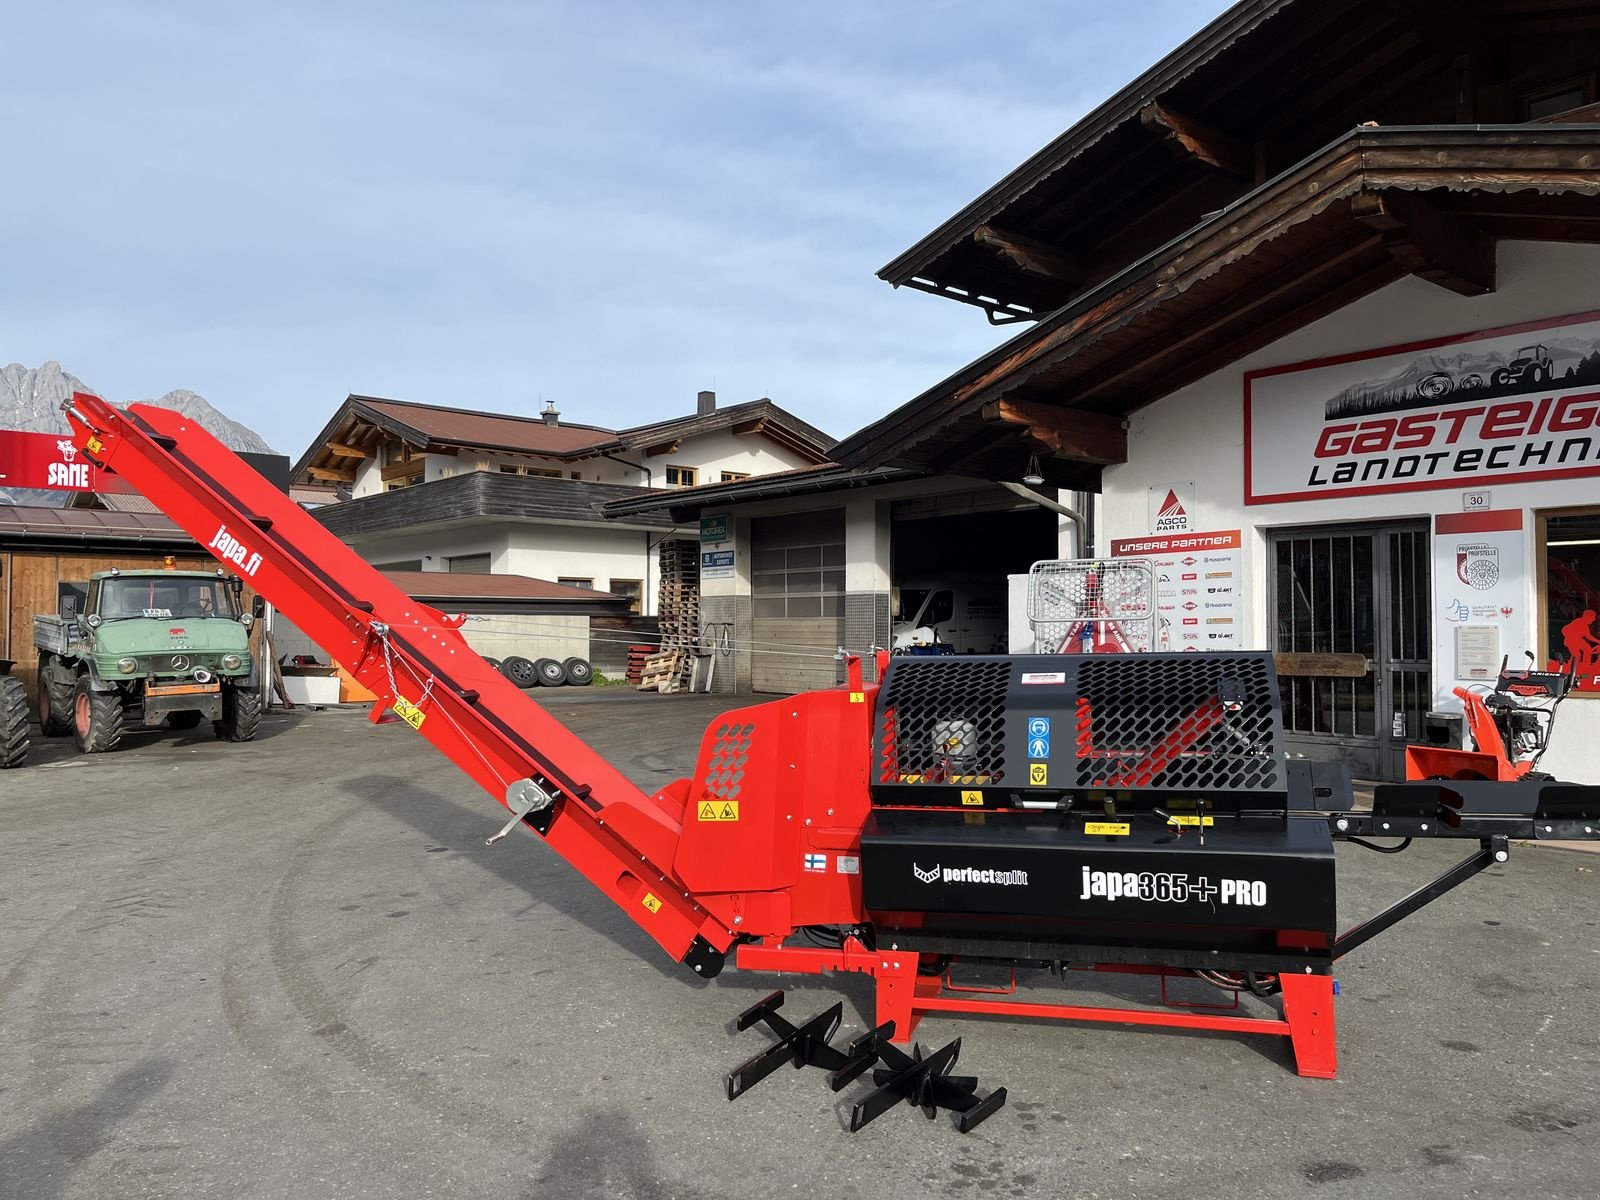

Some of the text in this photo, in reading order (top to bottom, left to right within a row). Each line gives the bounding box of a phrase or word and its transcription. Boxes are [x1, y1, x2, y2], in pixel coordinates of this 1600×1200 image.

[47, 462, 89, 488] SAME
[1470, 496, 1483, 506] 30
[1156, 516, 1187, 526] AGCO
[1156, 524, 1187, 532] PARTS
[208, 524, 264, 577] japa.fi
[943, 866, 1029, 886] perfectsplit
[1220, 878, 1267, 907] PRO
